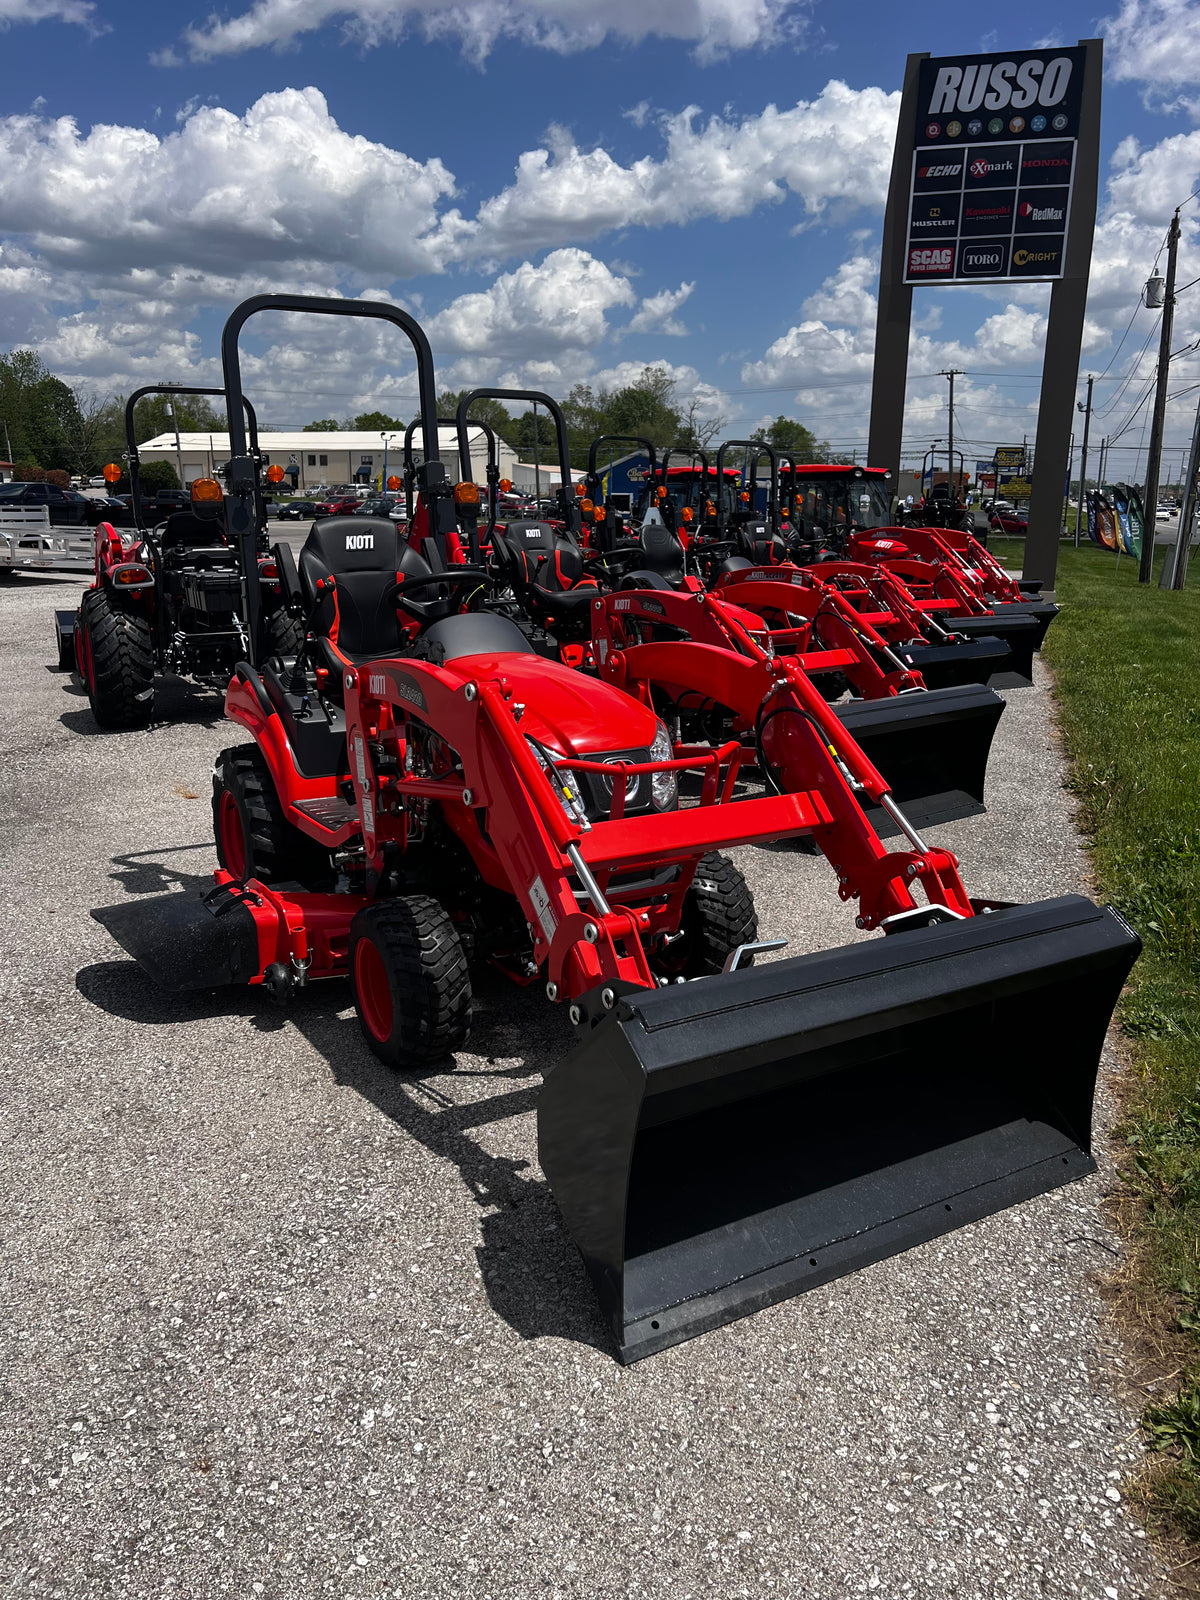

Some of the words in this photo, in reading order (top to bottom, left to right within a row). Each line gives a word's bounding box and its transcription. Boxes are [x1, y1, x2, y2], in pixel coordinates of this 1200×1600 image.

[928, 57, 1073, 114] RUSSO
[1022, 159, 1069, 167] HONDA
[926, 164, 962, 177] ECHO
[966, 206, 1010, 216] Kawasaki
[1032, 207, 1063, 221] RedMax
[911, 249, 952, 265] SCAG
[966, 254, 999, 265] TORO
[1018, 251, 1057, 263] WRIGHT
[525, 529, 541, 538] KIOTI
[1131, 516, 1140, 541] TURF
[345, 534, 374, 550] KIOTI
[614, 599, 630, 610] KIOTI
[369, 675, 386, 695] KIOTI
